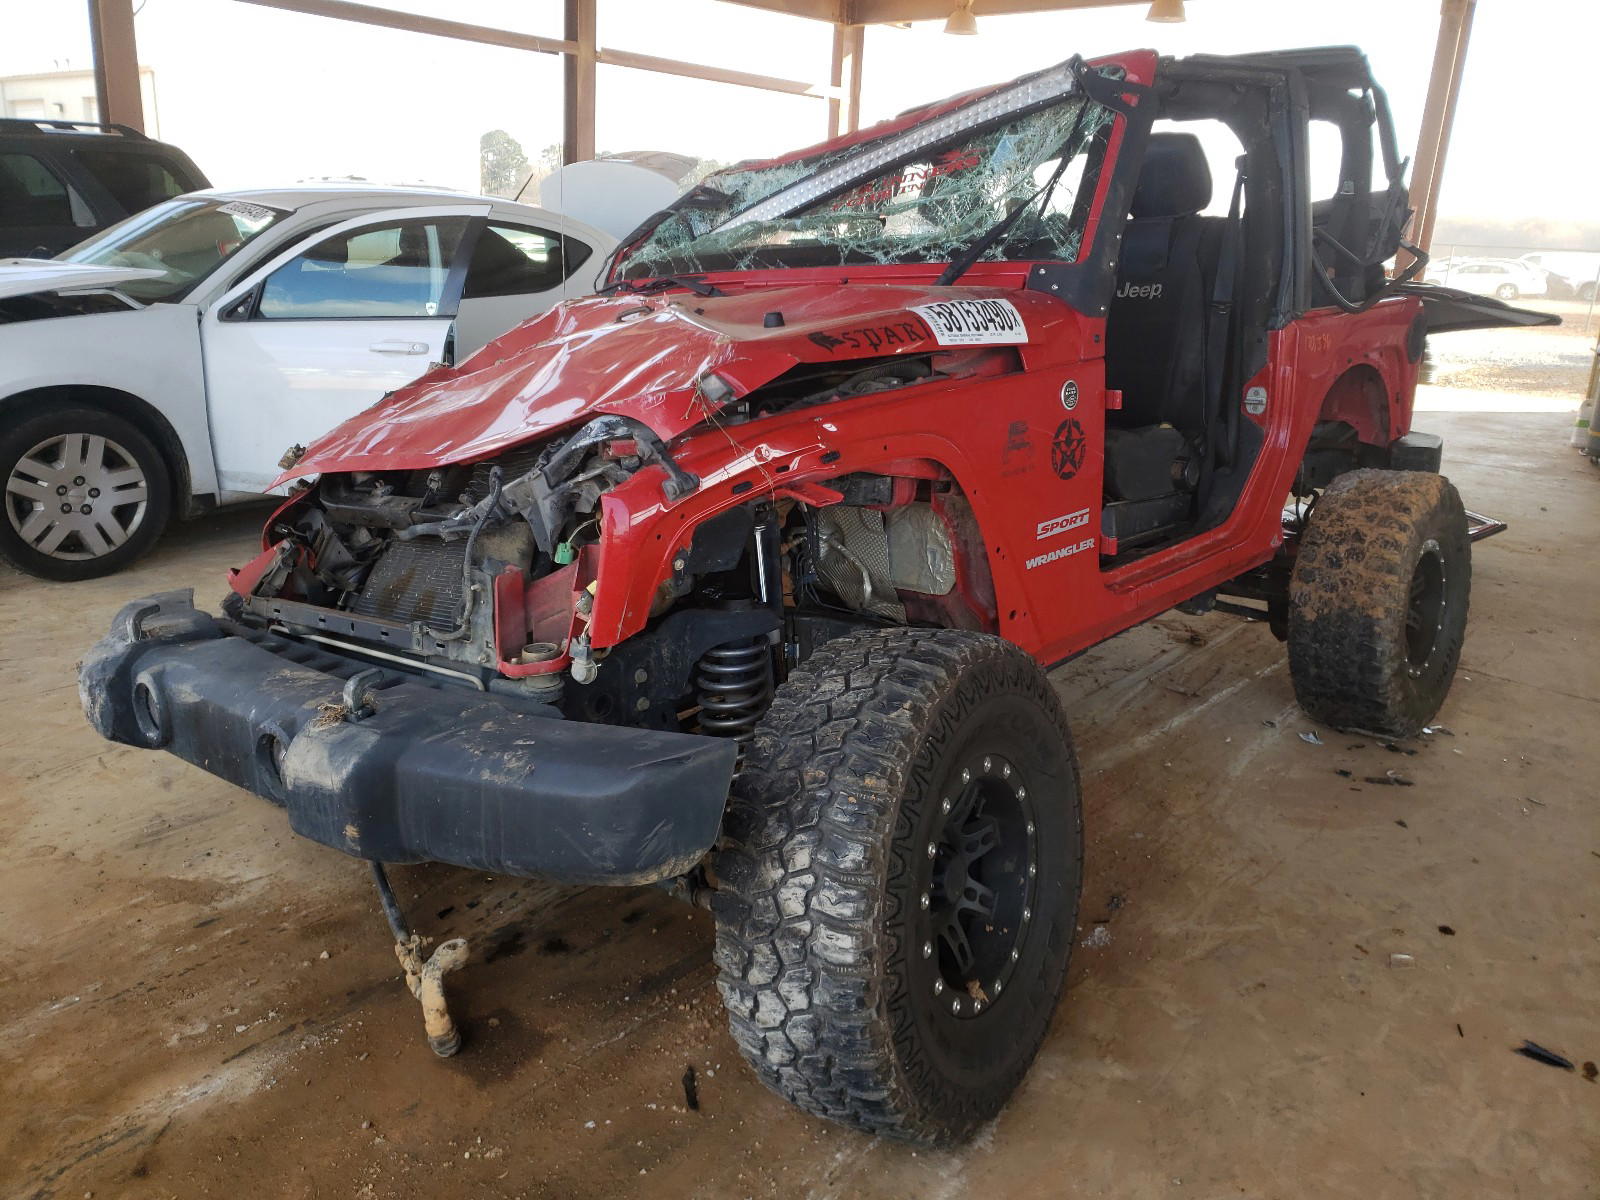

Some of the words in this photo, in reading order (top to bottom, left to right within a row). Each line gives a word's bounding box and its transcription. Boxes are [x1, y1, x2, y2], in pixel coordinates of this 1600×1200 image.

[1116, 281, 1163, 300] Jeep
[925, 300, 1014, 333] 58153490
[1037, 510, 1090, 537] SPORT
[1025, 538, 1095, 570] WRANGLER
